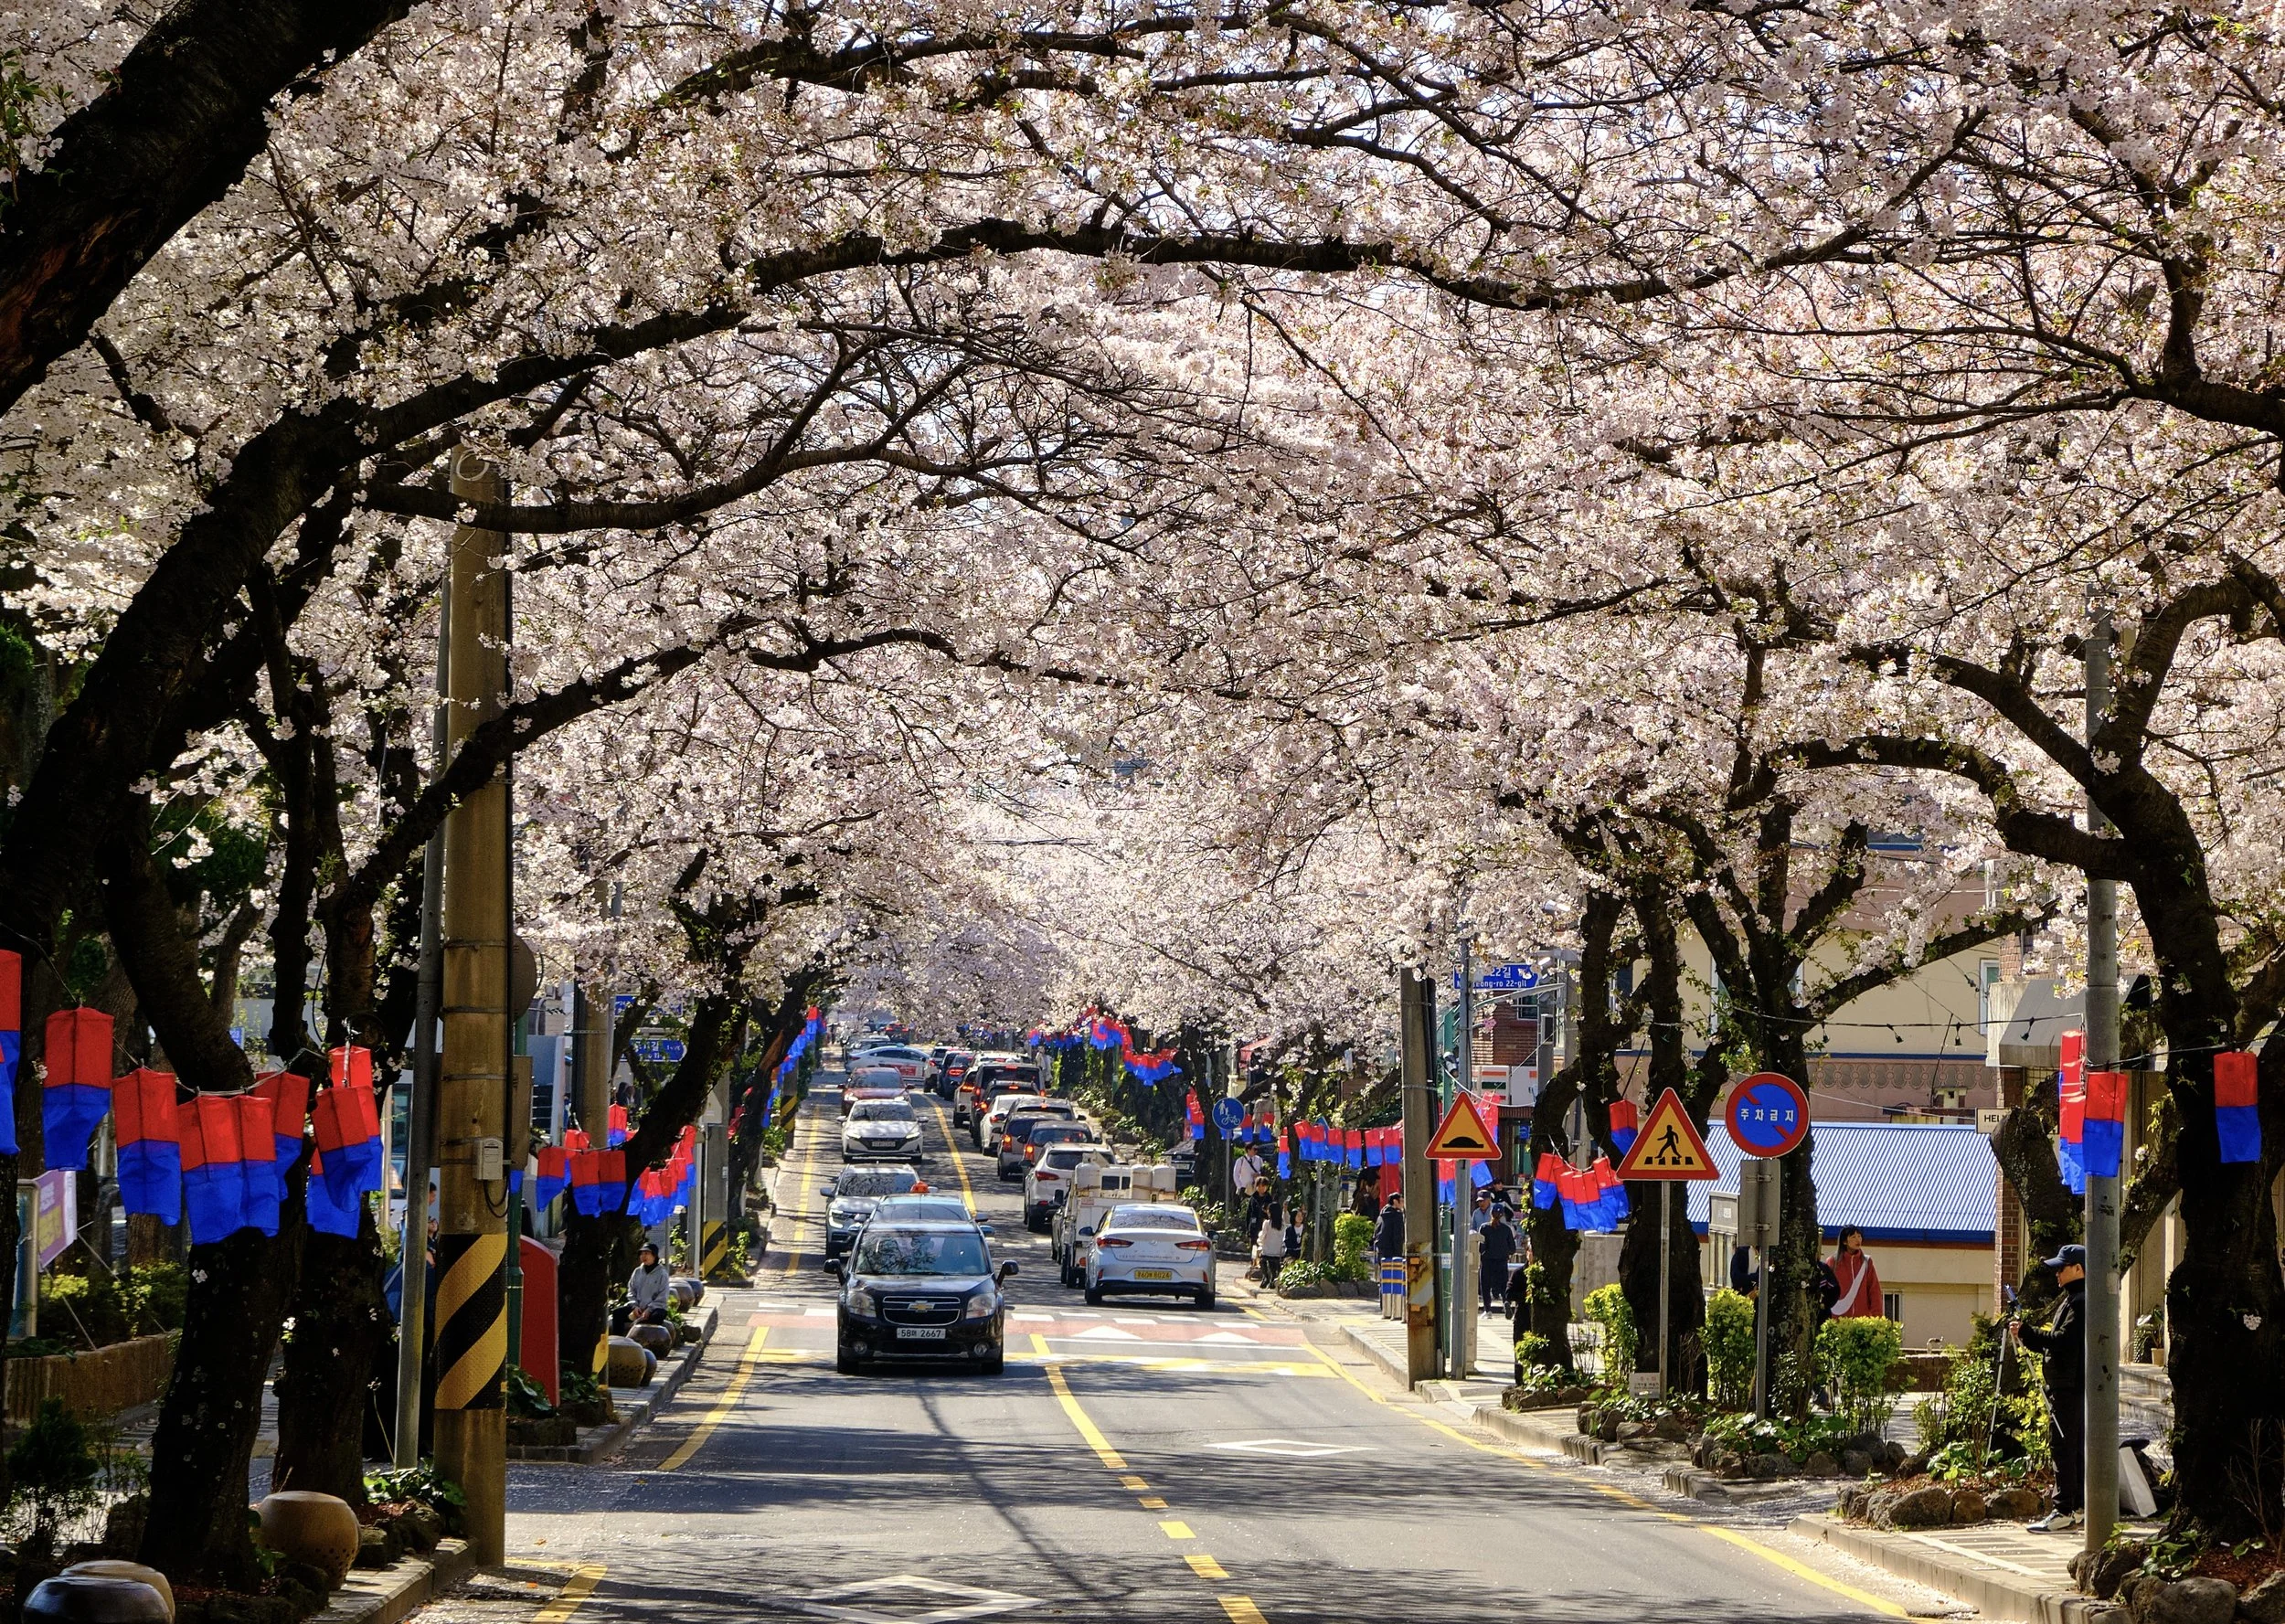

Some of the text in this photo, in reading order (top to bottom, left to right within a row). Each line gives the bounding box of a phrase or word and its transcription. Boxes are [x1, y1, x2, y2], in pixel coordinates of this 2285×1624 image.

[1505, 980, 1527, 988] 22-gil
[1740, 1108, 1794, 1122] 주차금지
[920, 1329, 941, 1338] 2667
